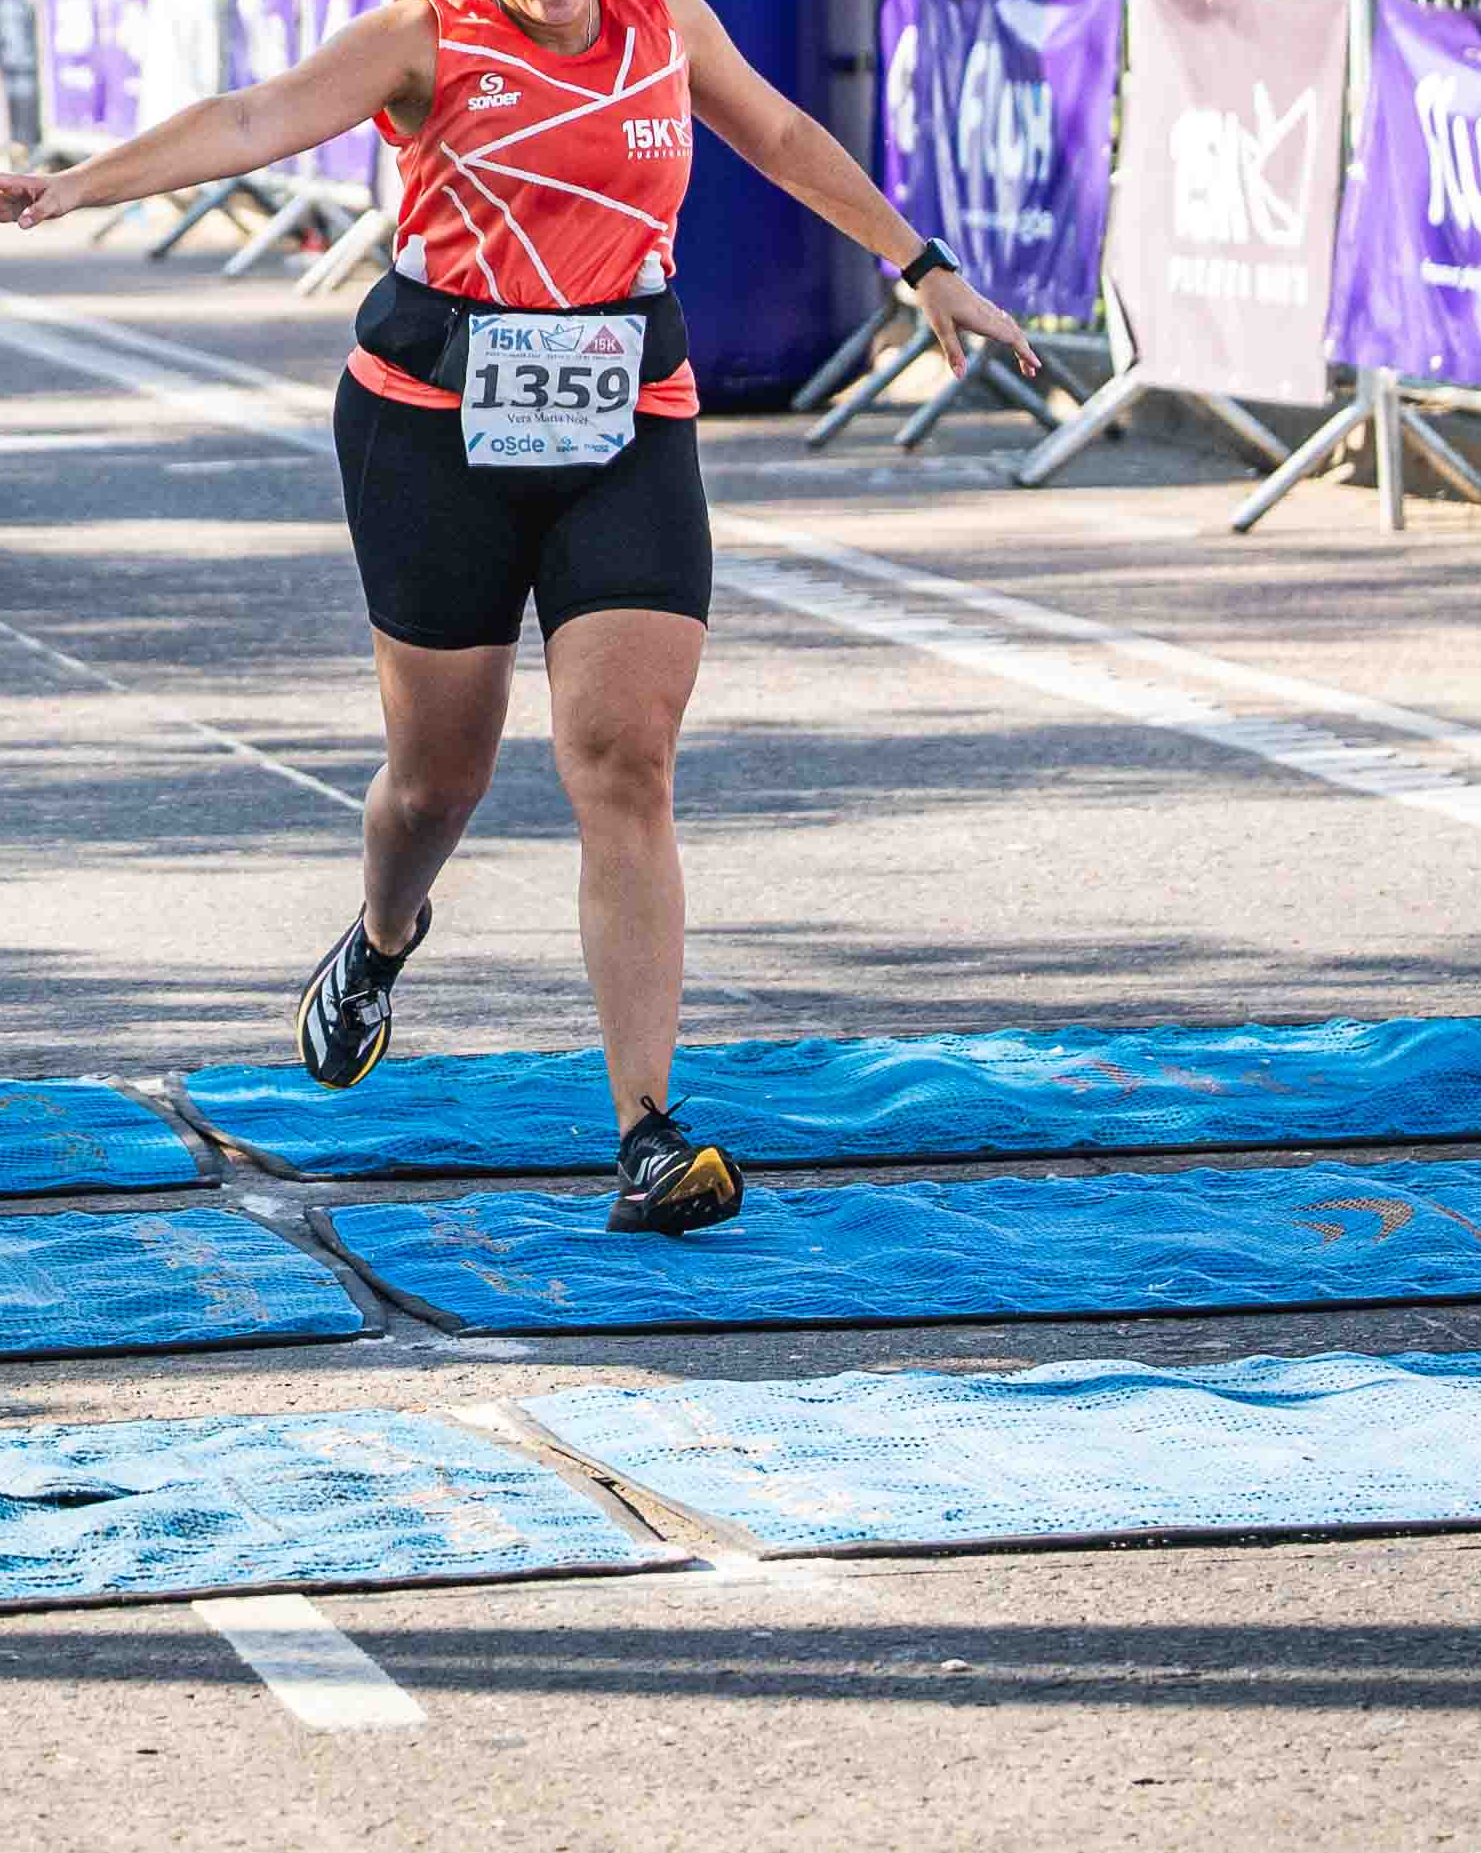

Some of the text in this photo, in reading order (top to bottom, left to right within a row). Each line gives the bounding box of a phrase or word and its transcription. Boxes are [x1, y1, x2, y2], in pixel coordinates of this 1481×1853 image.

[622, 118, 673, 149] 15K
[488, 328, 534, 351] 15K
[471, 363, 631, 414] 1359
